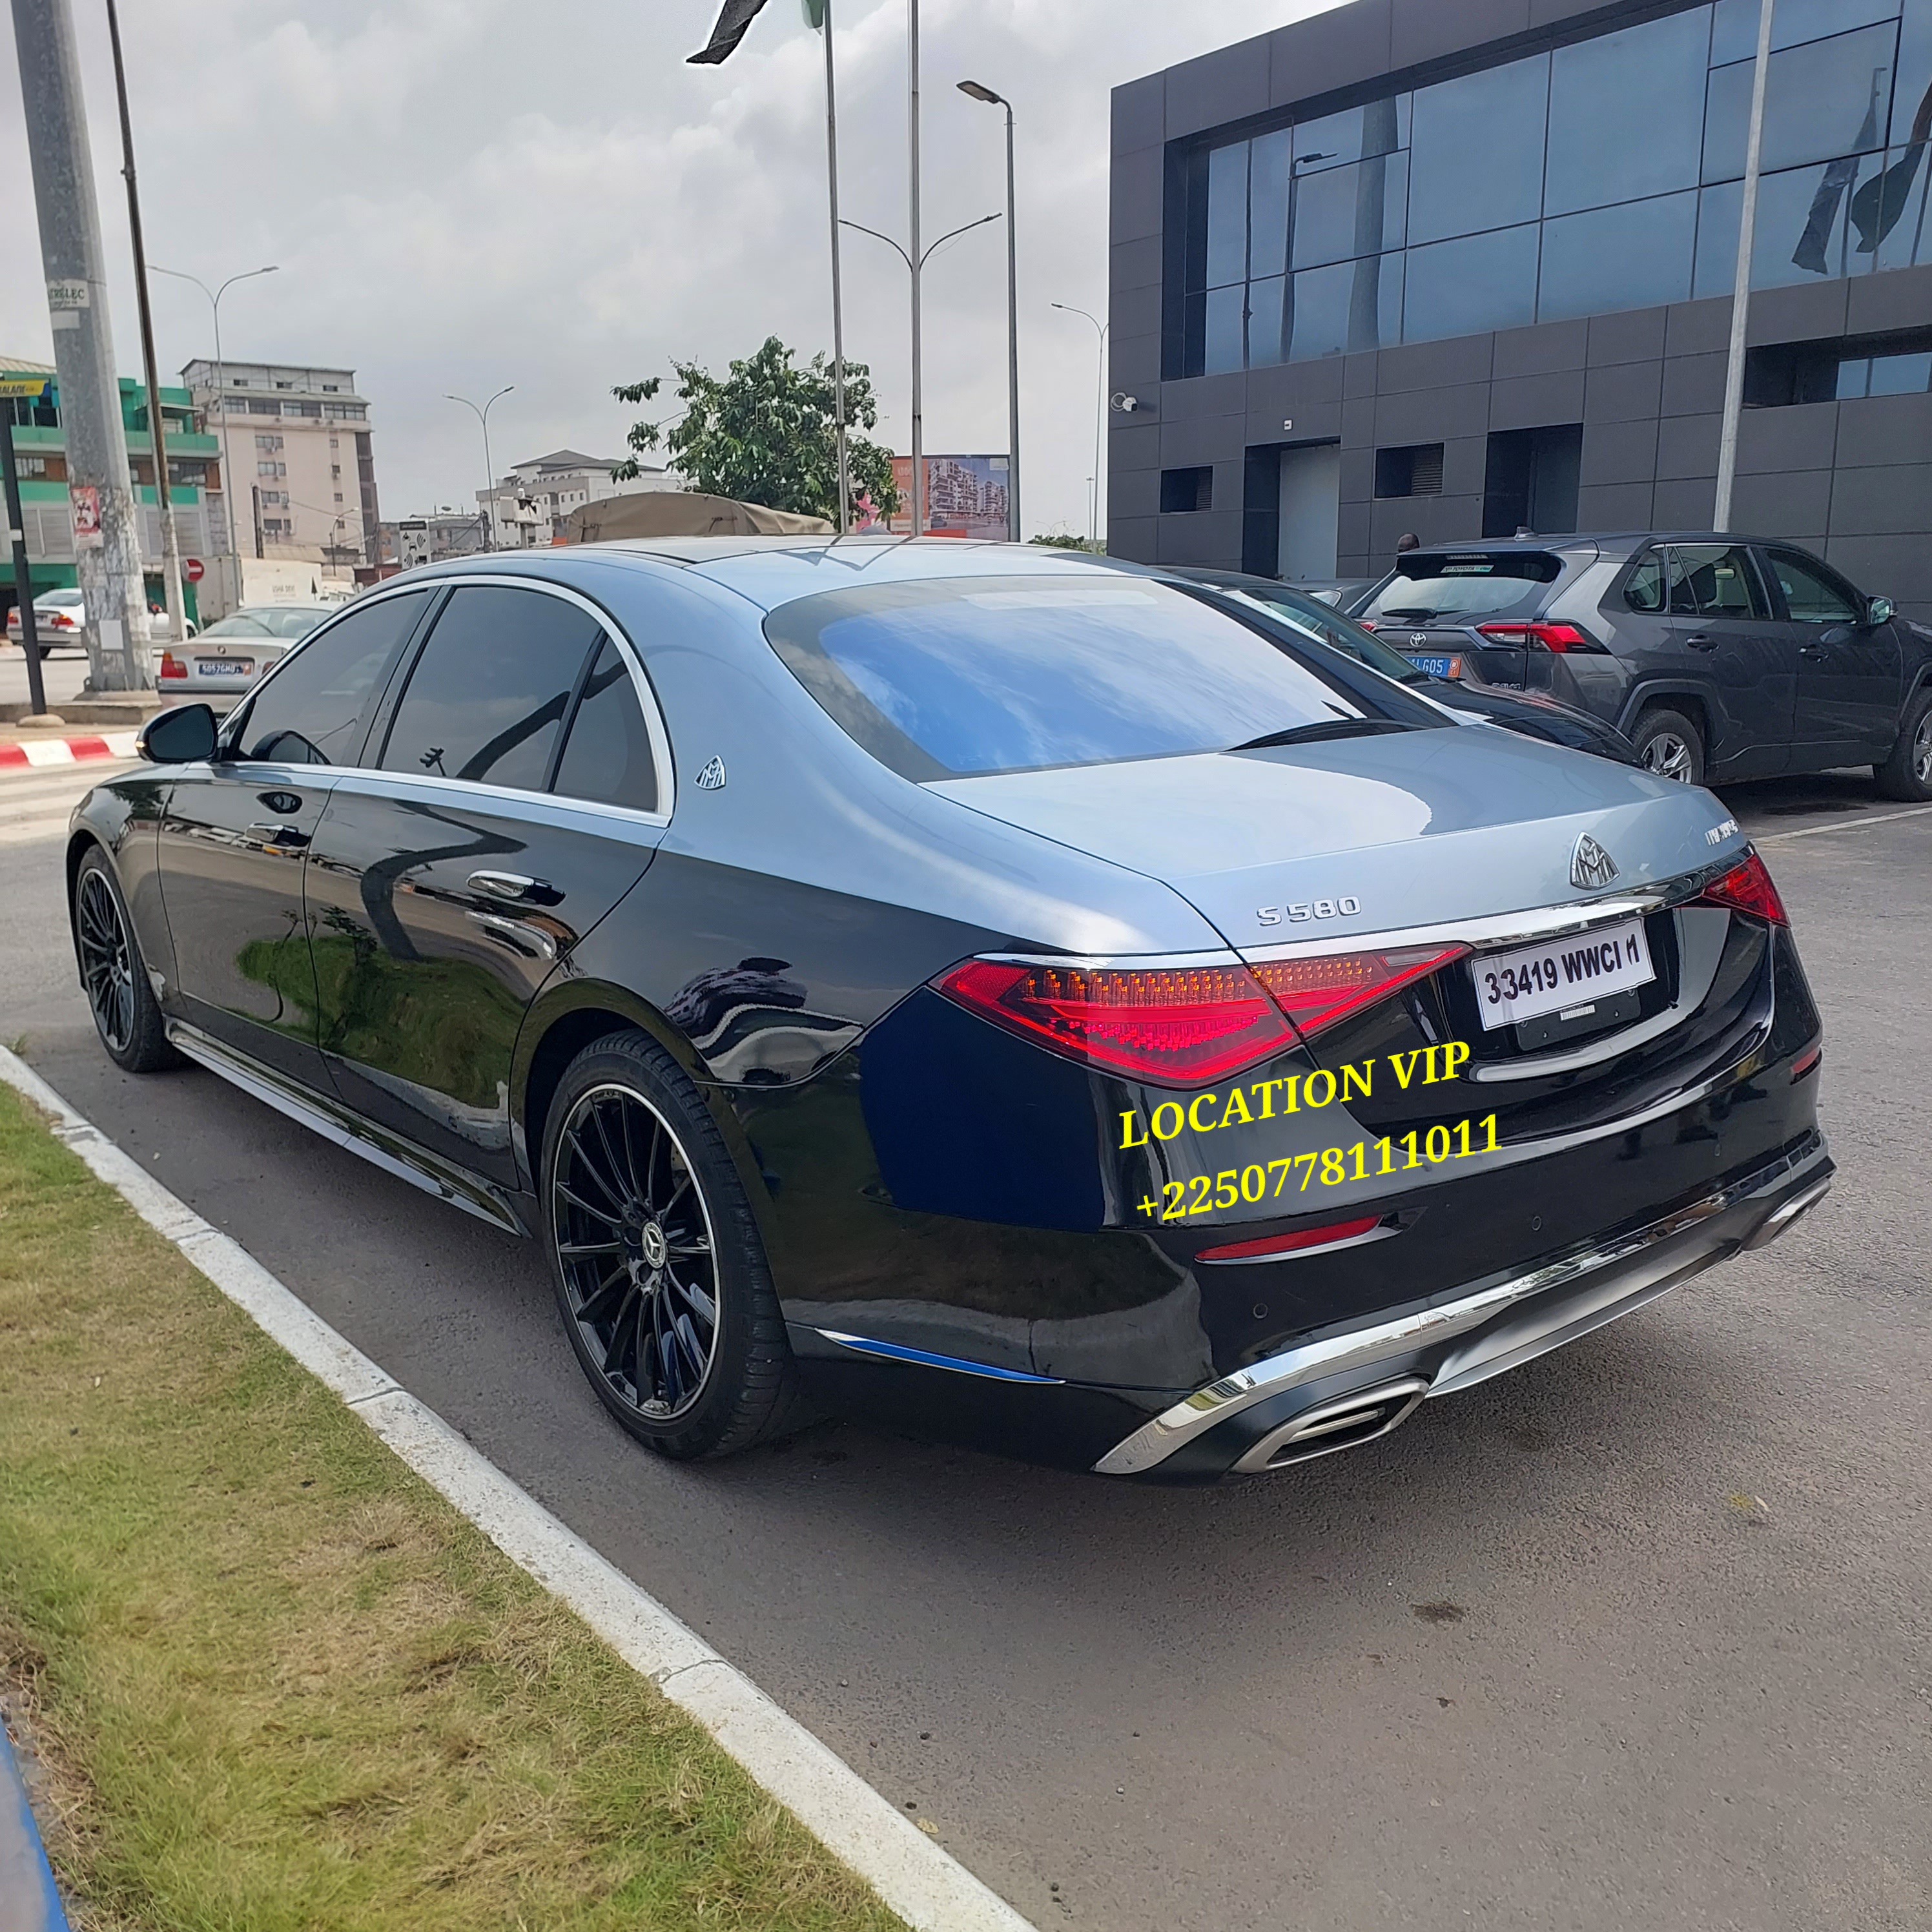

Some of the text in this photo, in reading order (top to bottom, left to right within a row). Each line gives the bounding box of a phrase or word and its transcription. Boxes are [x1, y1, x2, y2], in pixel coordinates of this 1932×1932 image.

[1257, 896, 1362, 927] S 580
[1485, 958, 1557, 1004] 33419
[1561, 941, 1622, 983] WWCI
